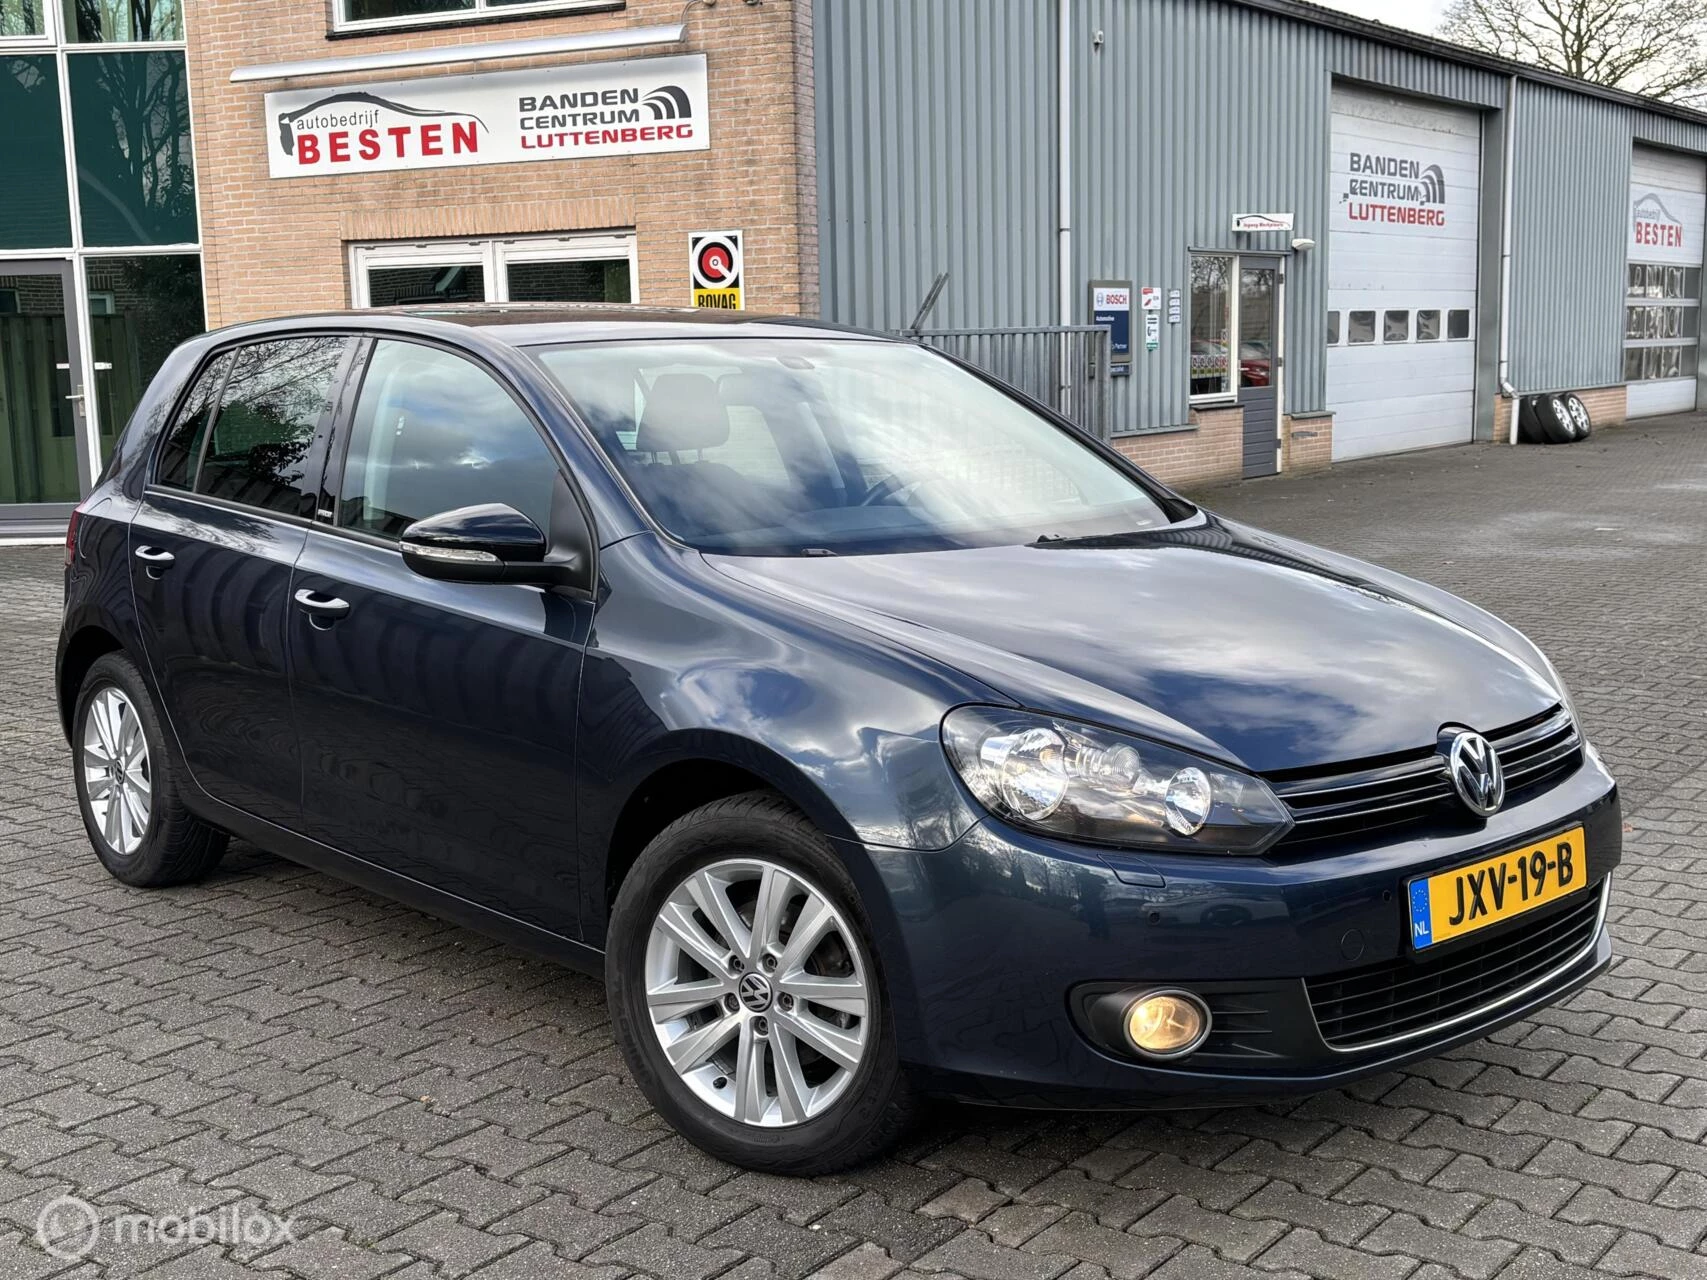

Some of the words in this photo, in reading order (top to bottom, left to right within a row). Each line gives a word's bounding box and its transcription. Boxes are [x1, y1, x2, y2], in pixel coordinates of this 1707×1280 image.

[518, 87, 640, 113] BANDEN
[297, 109, 380, 130] autobedrijf
[519, 108, 641, 131] CENTRUM
[297, 121, 479, 165] BESTEN
[521, 123, 694, 149] LUTTENBERG
[1349, 152, 1420, 180] BANDEN
[1348, 202, 1445, 226] LUTTENBERG
[1635, 221, 1683, 248] BESTEN
[1105, 294, 1128, 305] BOSCH
[1448, 841, 1574, 926] JXV-19-B
[1414, 919, 1430, 938] NL
